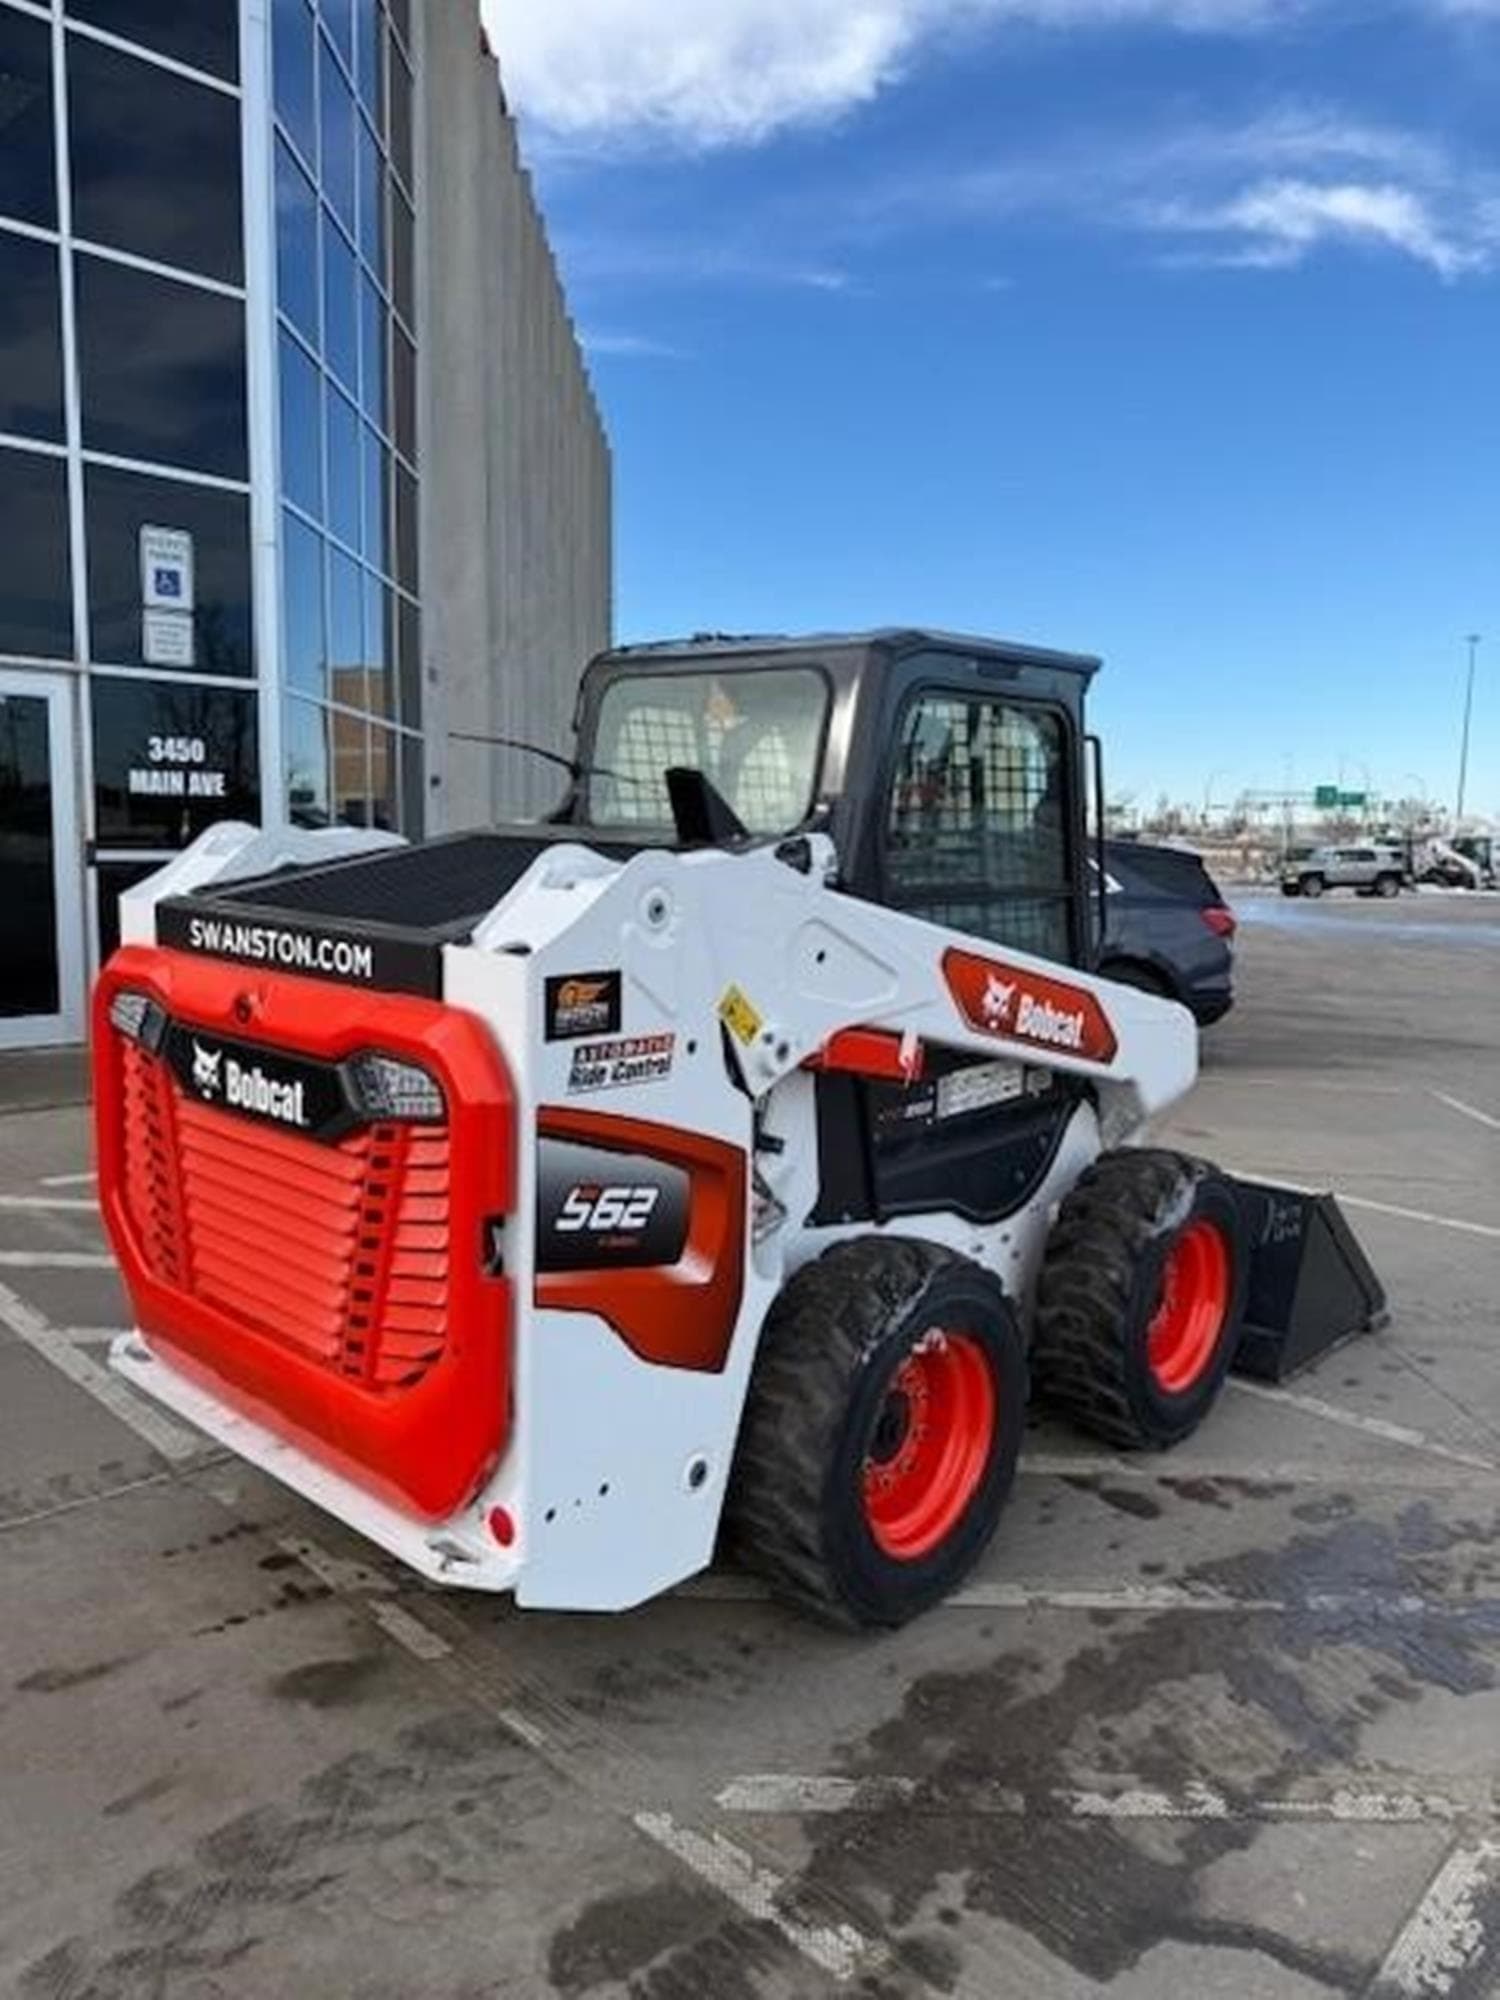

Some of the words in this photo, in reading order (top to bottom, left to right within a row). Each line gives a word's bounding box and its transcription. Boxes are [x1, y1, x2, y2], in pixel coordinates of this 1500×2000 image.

[148, 736, 205, 762] 3450
[129, 769, 184, 794] MAIN
[188, 771, 225, 796] AVE
[189, 919, 373, 978] SWANSTON.COM
[1015, 993, 1084, 1048] Bobcat
[224, 1060, 305, 1124] Bobcat
[555, 1187, 659, 1231] S62
